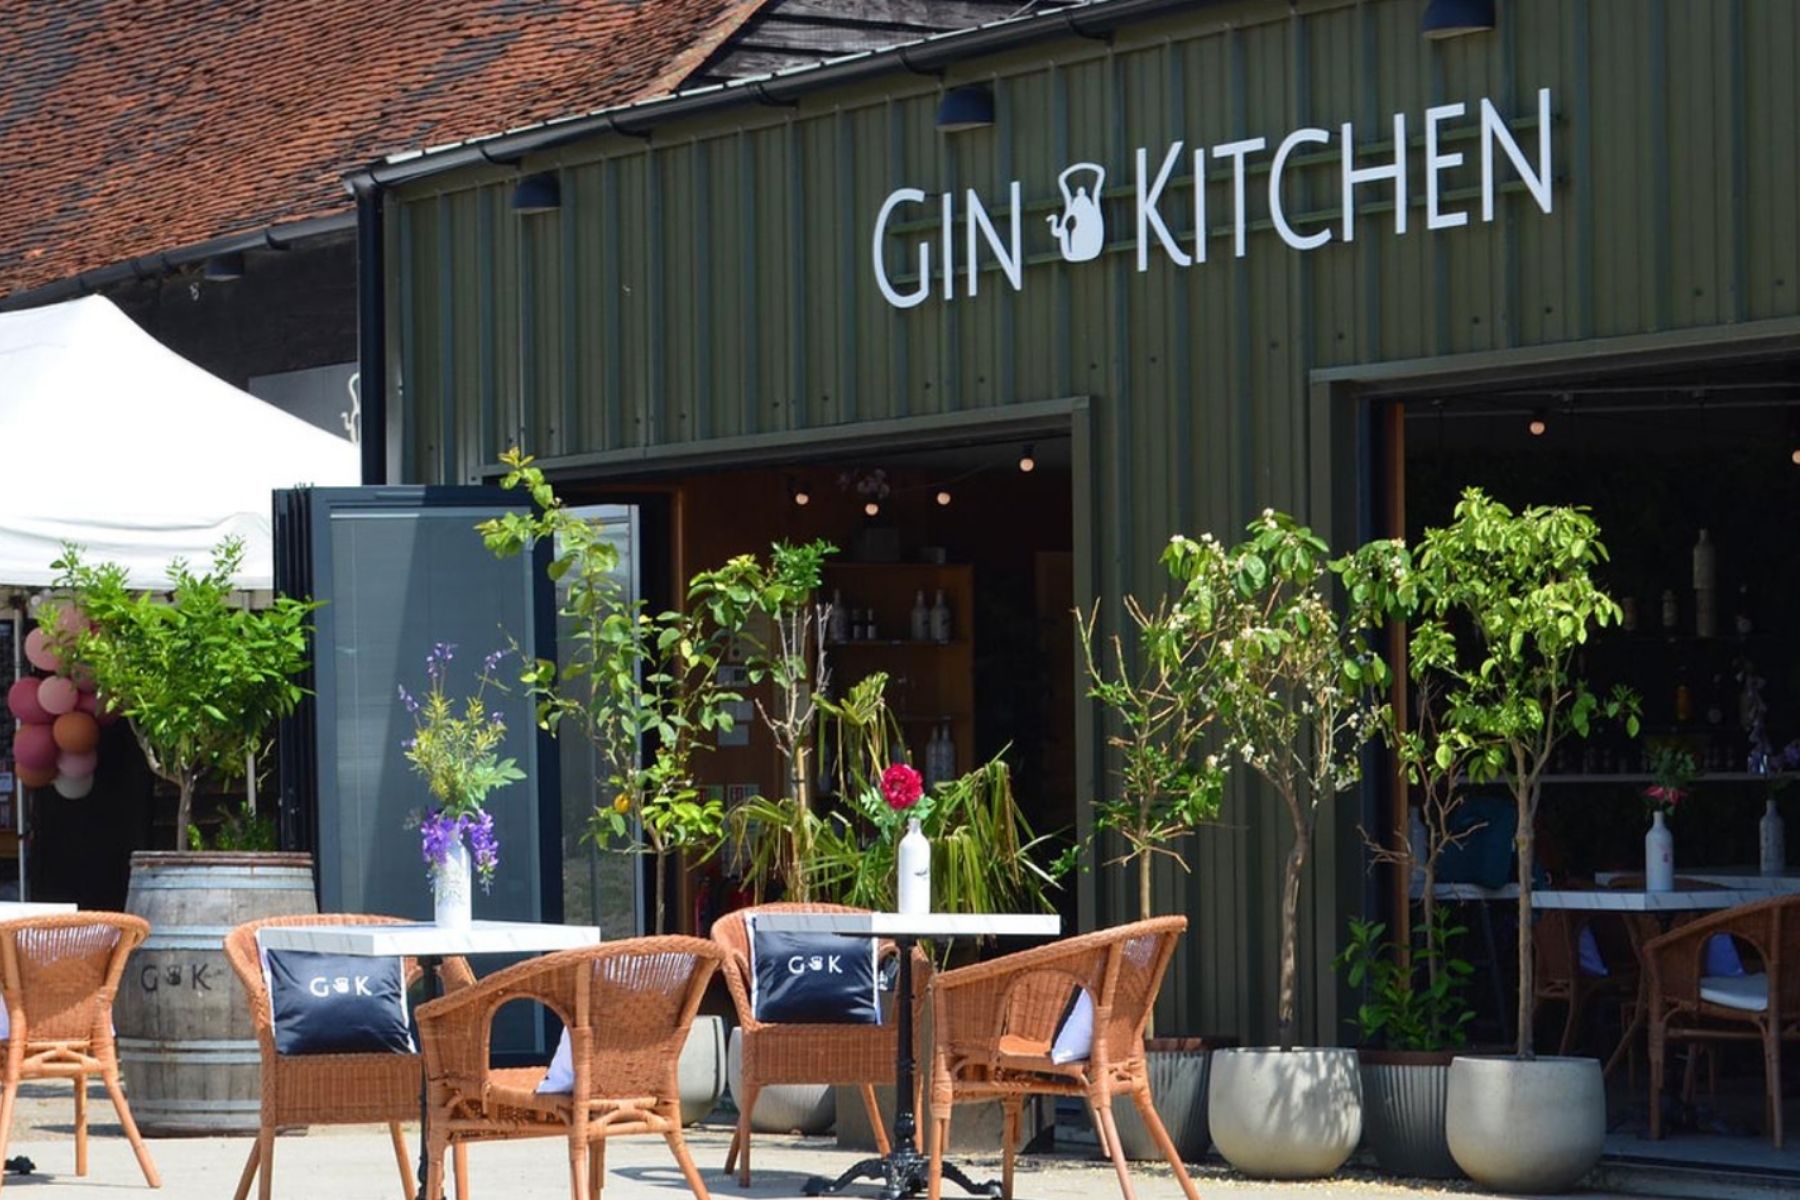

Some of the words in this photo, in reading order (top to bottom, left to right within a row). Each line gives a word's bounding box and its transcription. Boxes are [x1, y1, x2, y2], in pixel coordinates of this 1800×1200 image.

[872, 180, 1022, 309] GIN
[1136, 87, 1553, 273] KITCHEN
[140, 963, 158, 992] G
[192, 963, 213, 991] K
[788, 955, 805, 975] G
[828, 954, 843, 974] K
[310, 976, 329, 998] G
[355, 975, 373, 997] K
